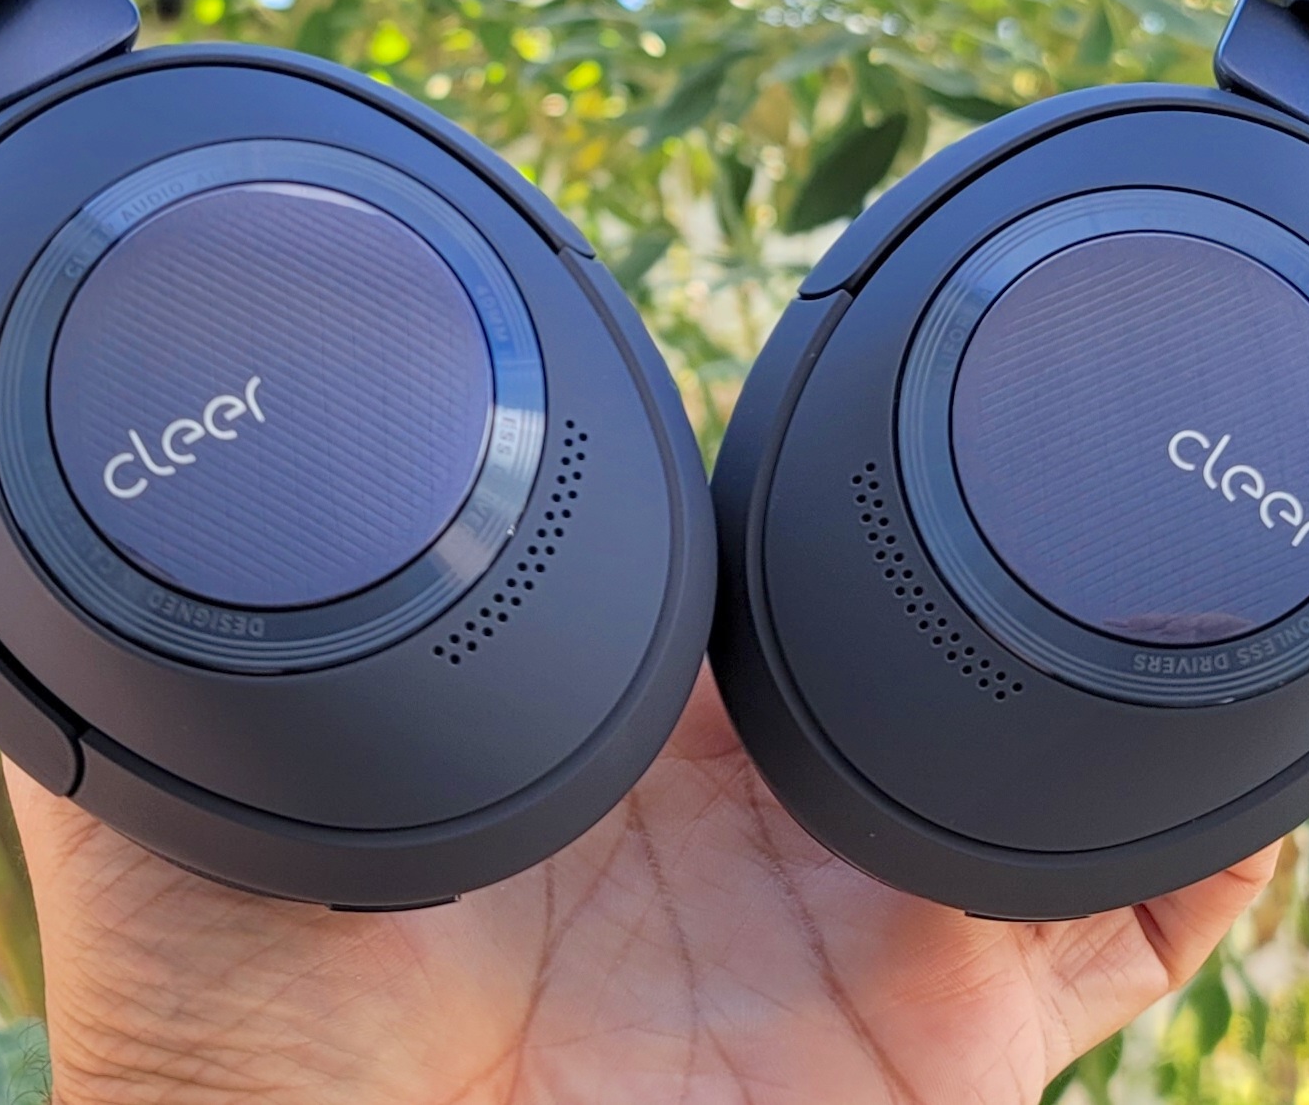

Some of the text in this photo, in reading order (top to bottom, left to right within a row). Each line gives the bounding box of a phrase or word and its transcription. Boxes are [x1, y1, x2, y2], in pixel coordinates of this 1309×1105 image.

[119, 181, 185, 224] AUDIO
[103, 375, 266, 499] cleer
[147, 591, 267, 638] DESIGNED
[1133, 653, 1231, 676] DRIVERS
